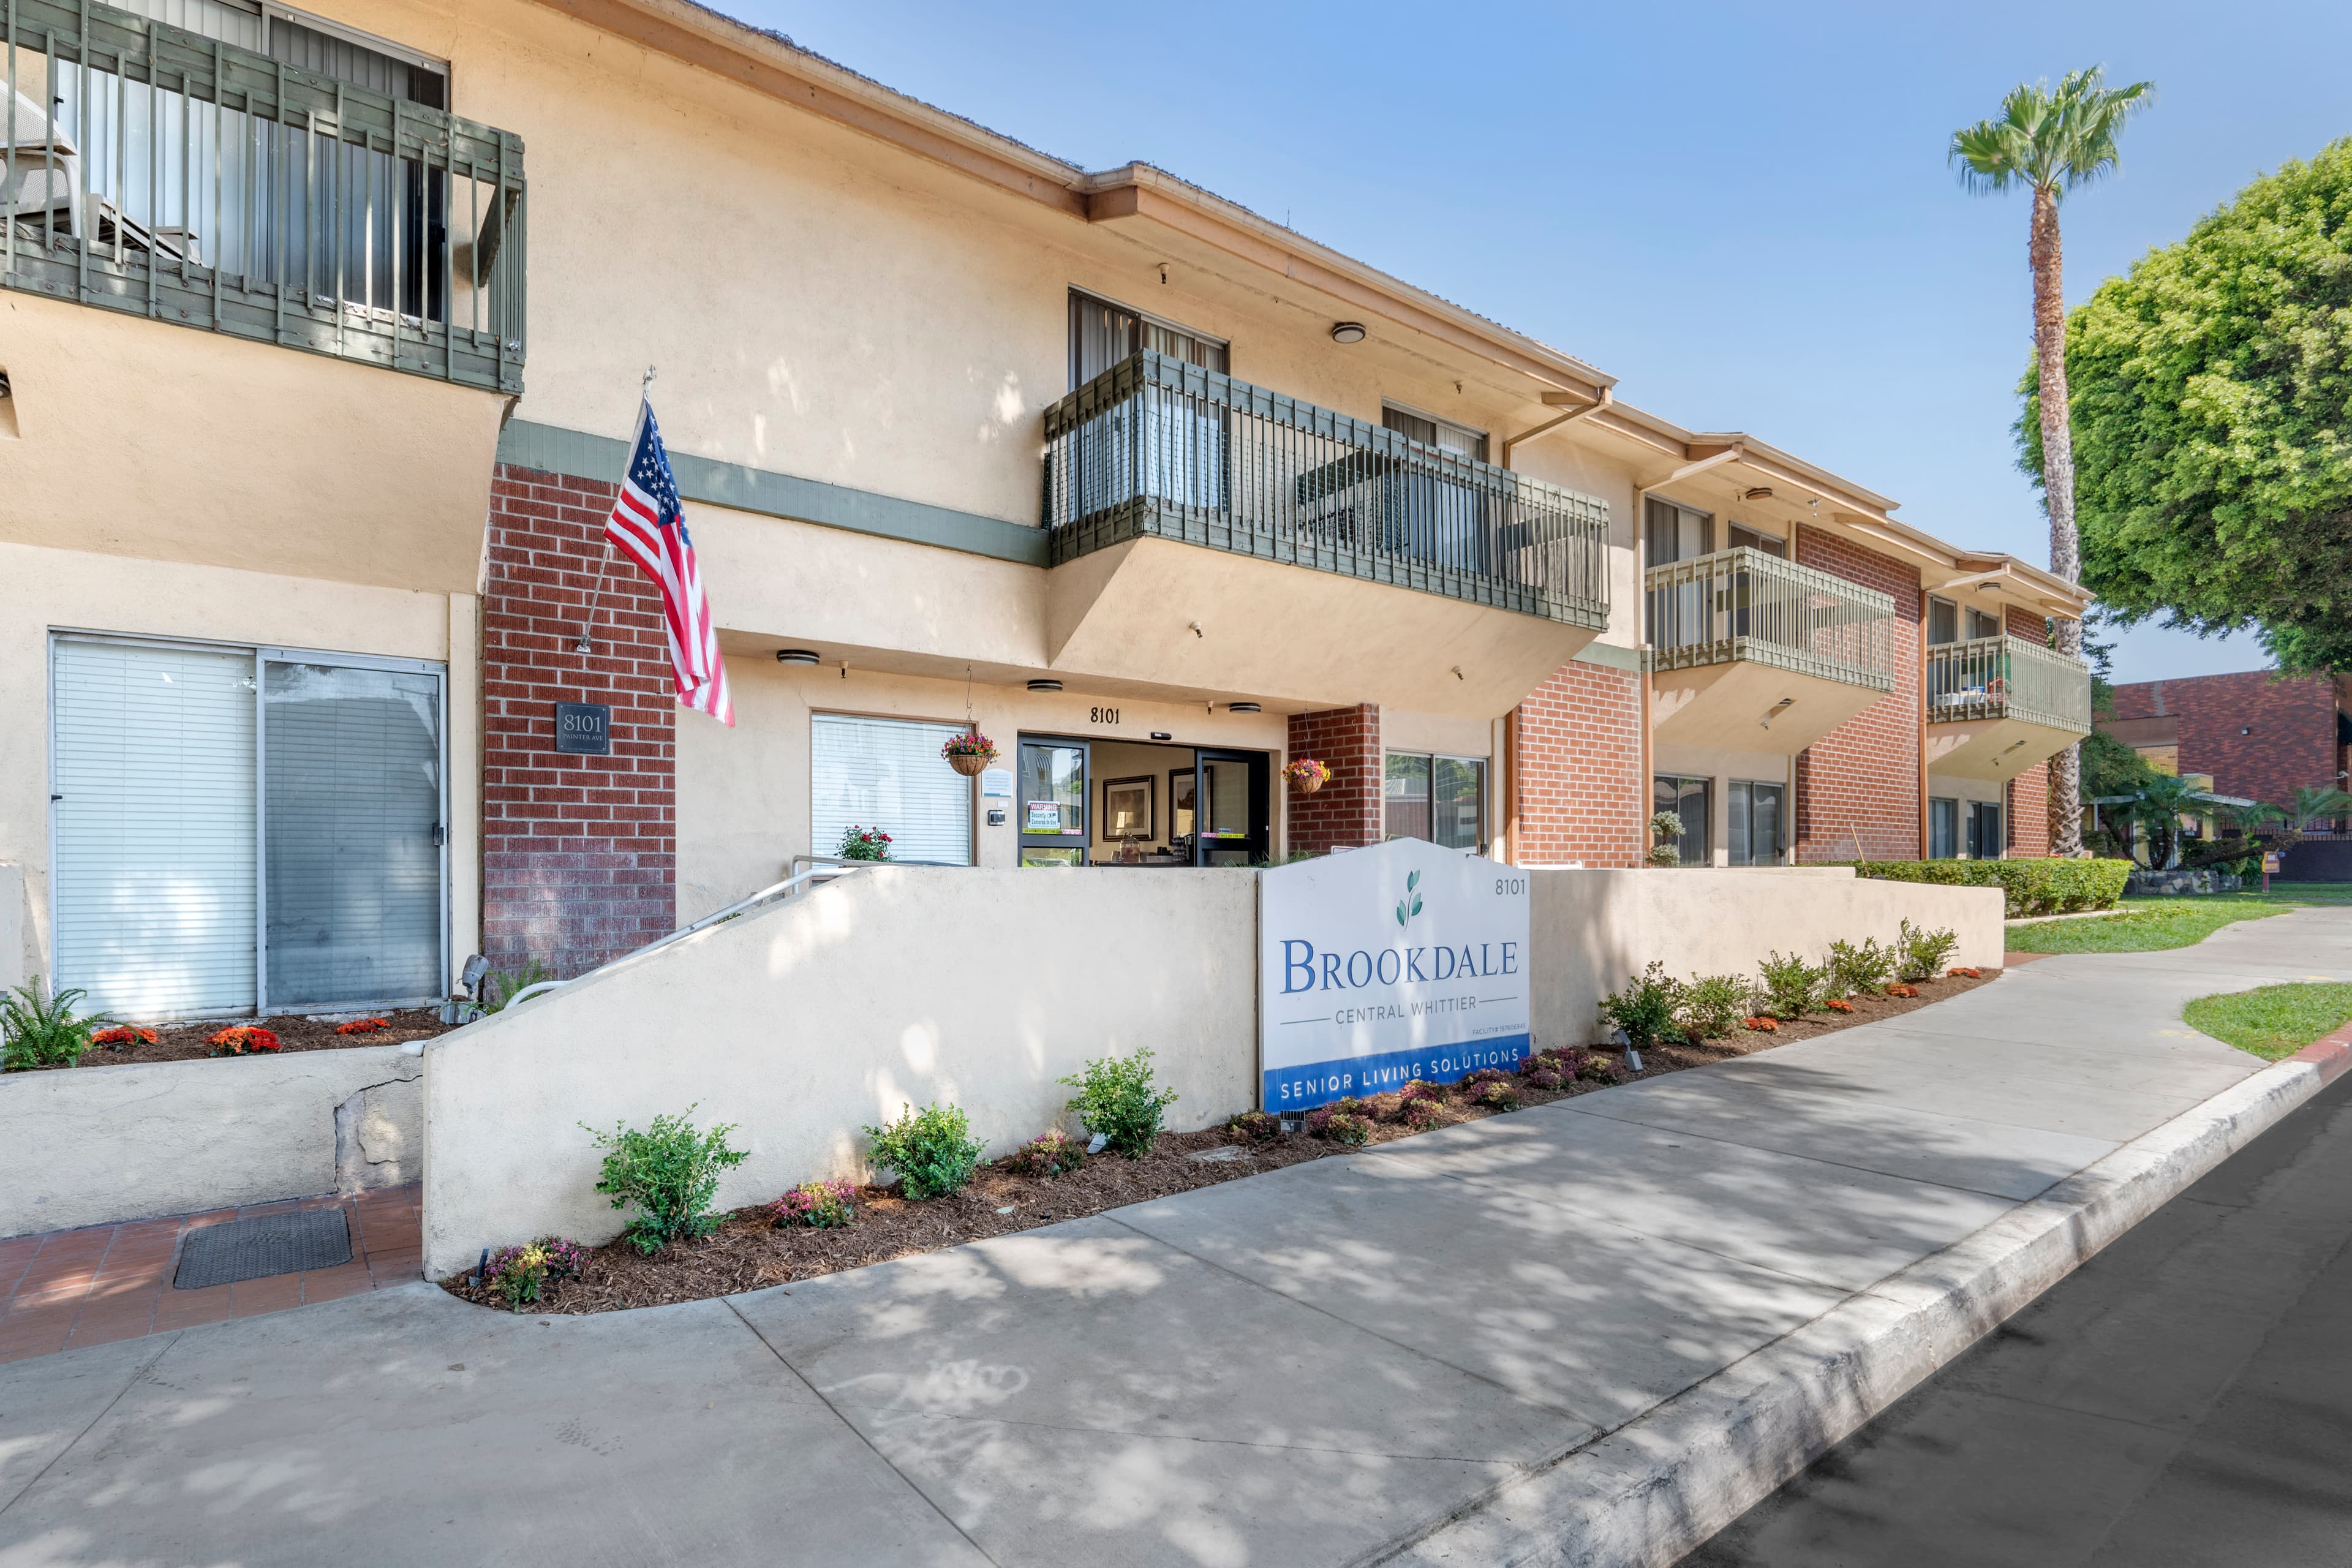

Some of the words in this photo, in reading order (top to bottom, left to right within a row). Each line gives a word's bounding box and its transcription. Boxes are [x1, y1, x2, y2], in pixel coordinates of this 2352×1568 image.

[564, 714, 602, 733] 8101
[1090, 707, 1120, 725] 8101
[1495, 878, 1525, 895] 8101
[1280, 940, 1518, 994] BROOKDALE
[1335, 1004, 1404, 1025] CENTRAL
[1411, 996, 1477, 1016] WHITTIER
[1281, 1074, 1352, 1099] SENIOR
[1363, 1063, 1422, 1087] LIVING
[1431, 1048, 1519, 1074] SOLUTIONS
